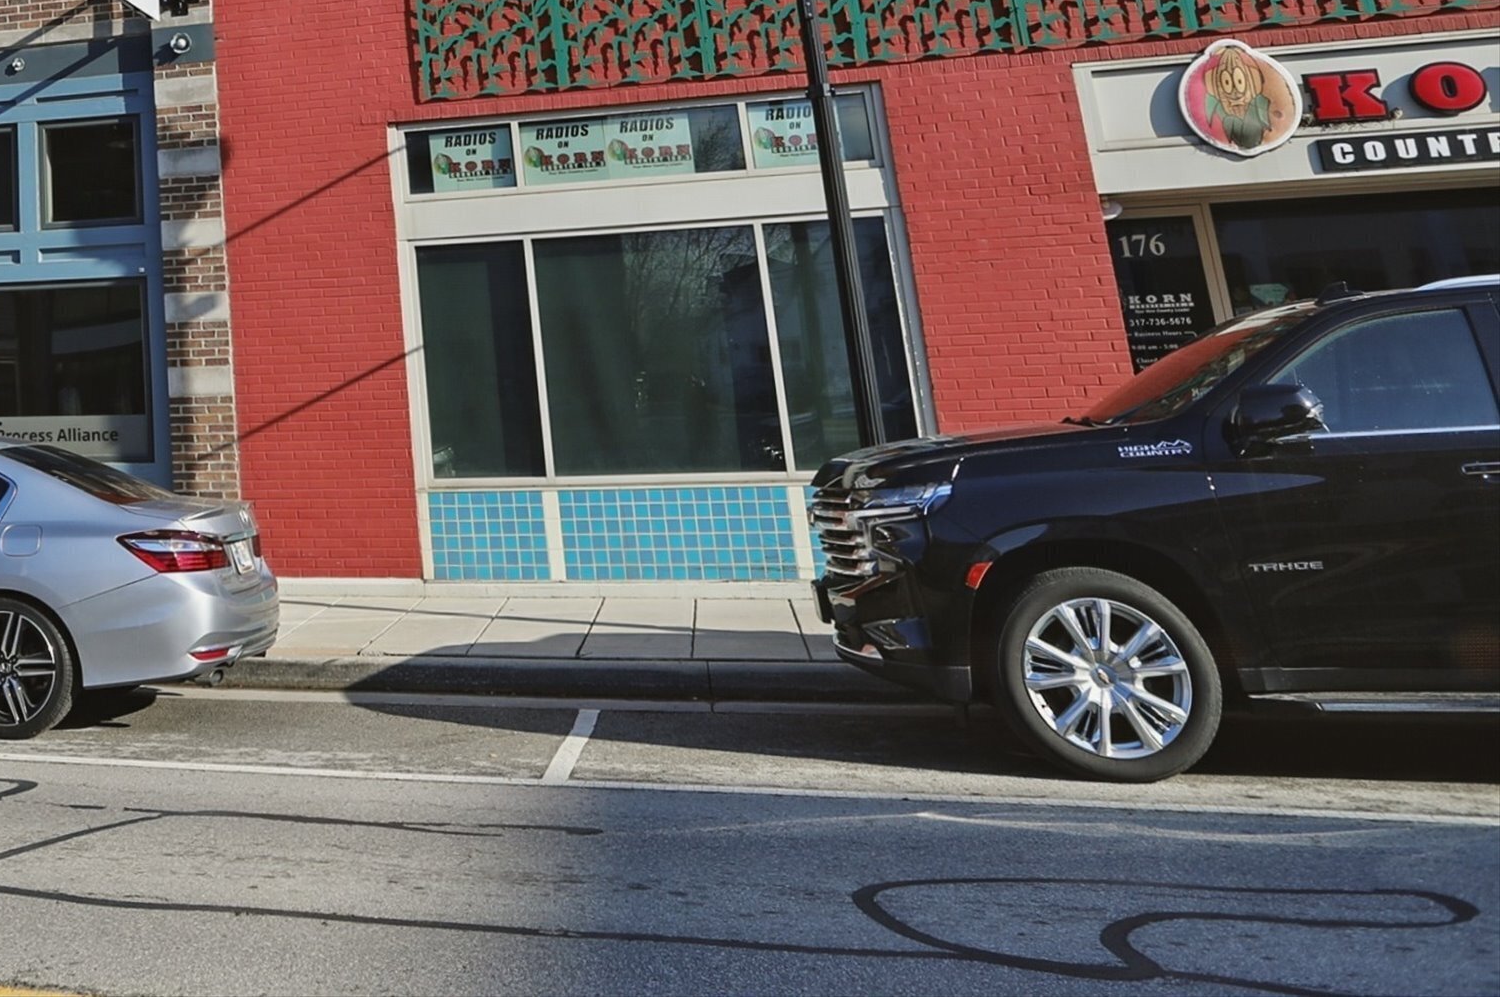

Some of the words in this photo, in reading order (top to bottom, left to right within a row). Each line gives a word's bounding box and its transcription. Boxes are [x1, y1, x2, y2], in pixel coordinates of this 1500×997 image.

[765, 105, 812, 121] RADIO
[536, 124, 589, 140] RADIOS
[619, 117, 675, 133] RADIOS
[789, 122, 801, 130] ON
[445, 132, 497, 148] RADIOS
[557, 141, 569, 149] ON
[1118, 233, 1165, 258] 176
[1128, 293, 1193, 304] KORN
[1129, 317, 1192, 327] 317-736-5676
[57, 428, 119, 442] Alliance
[1248, 561, 1324, 572] TAHOE
